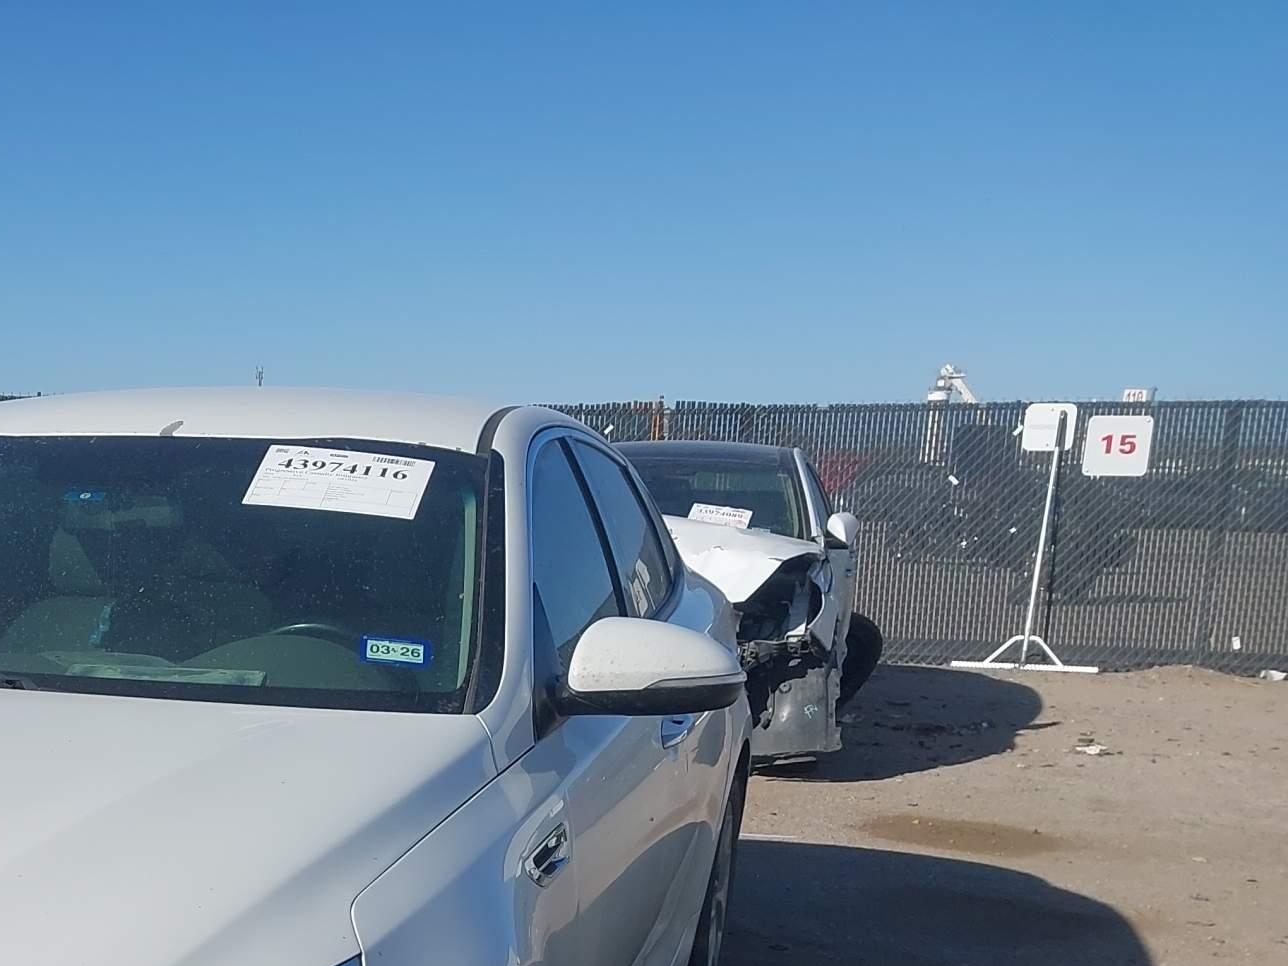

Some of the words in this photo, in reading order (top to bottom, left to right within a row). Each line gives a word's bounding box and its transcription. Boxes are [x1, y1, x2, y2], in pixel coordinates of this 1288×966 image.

[1101, 434, 1137, 455] 15
[277, 457, 409, 481] 43974116
[370, 644, 391, 655] 03
[400, 646, 421, 658] 26
